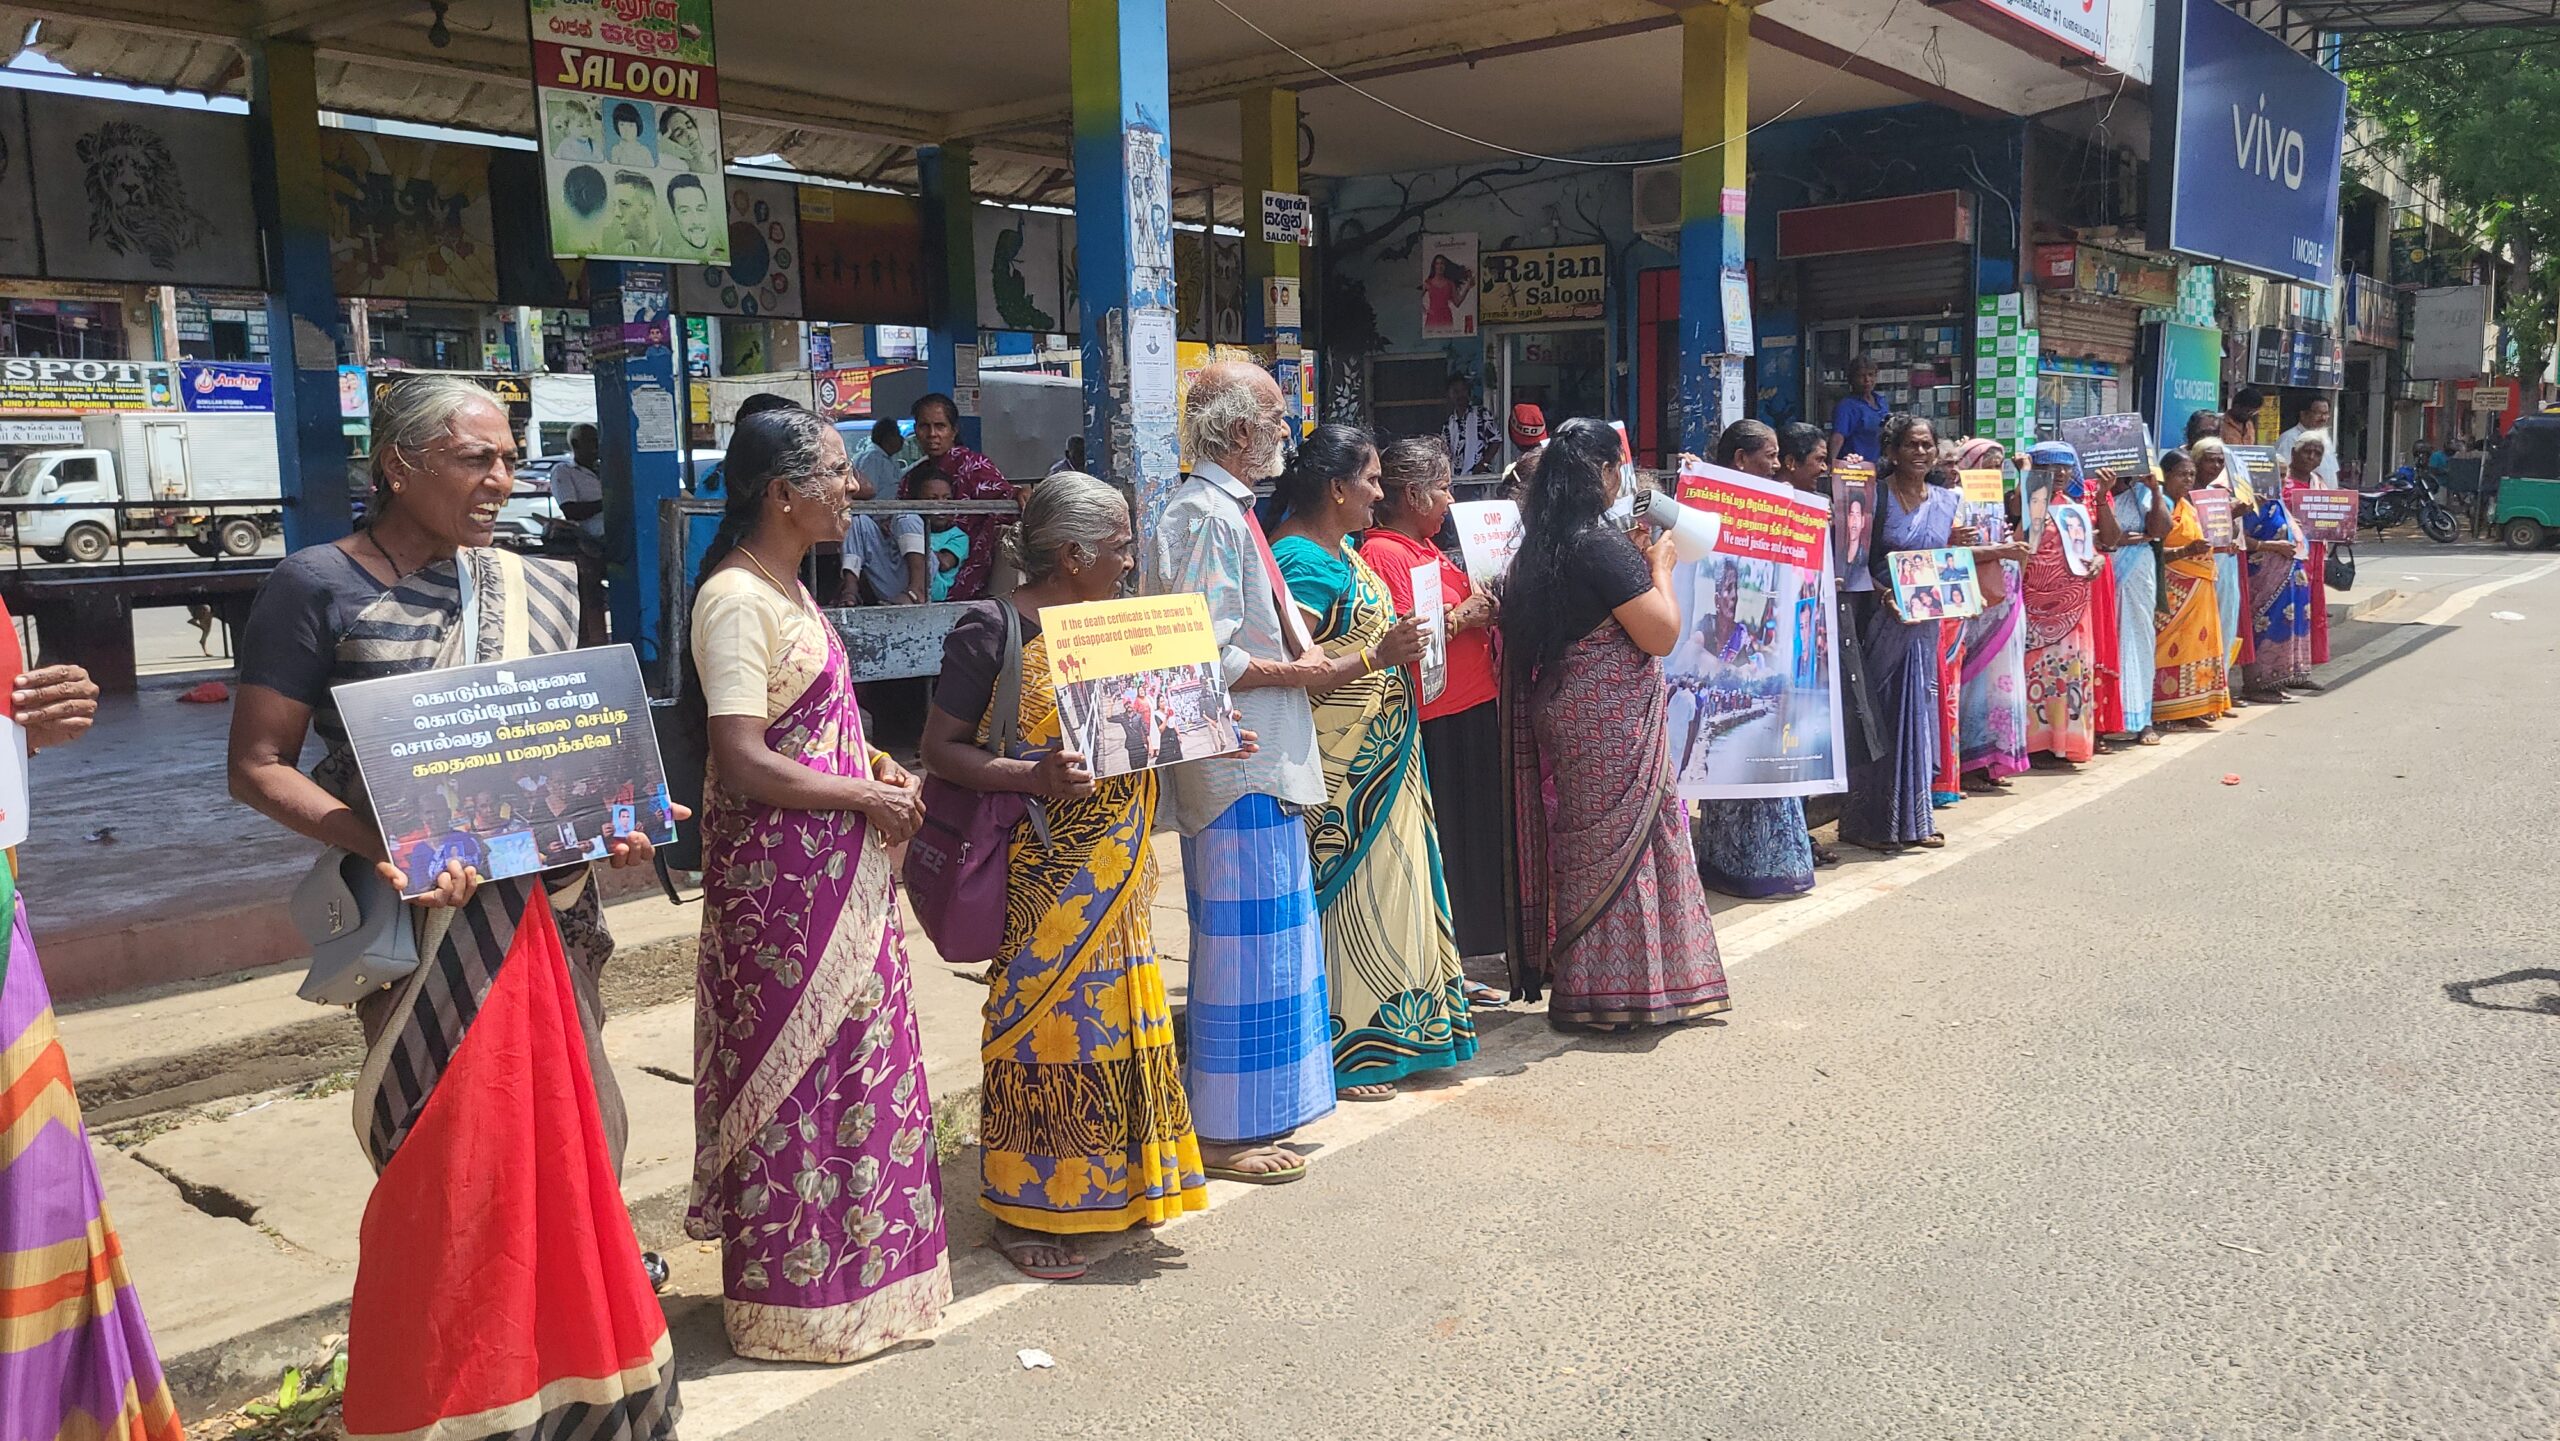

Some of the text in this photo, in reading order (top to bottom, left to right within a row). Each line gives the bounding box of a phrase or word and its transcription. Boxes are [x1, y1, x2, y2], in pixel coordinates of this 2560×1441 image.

[558, 47, 699, 100] SALOON
[2233, 92, 2304, 190] vivo
[1265, 231, 1299, 242] SALOON
[2296, 238, 2323, 267] MOBILE
[1494, 252, 1603, 288] Rajan
[1526, 286, 1601, 305] Saloon
[883, 327, 911, 340] FedEx
[5, 360, 140, 382] SPOT
[215, 373, 261, 387] Anchor
[3, 400, 23, 408] KIND
[25, 400, 36, 408] OF
[37, 400, 67, 408] MOBILE
[69, 401, 111, 409] REPAIRING
[13, 433, 21, 441] &
[26, 432, 65, 442] English
[1484, 513, 1501, 525] OMP
[1723, 531, 1735, 545] We
[1735, 534, 1750, 547] need
[1749, 536, 1770, 551] justice
[1771, 541, 1782, 553] and
[1061, 606, 1192, 632] If the death certificate is the answer to
[1057, 620, 1204, 650] our disappeared children, then who is the
[1130, 642, 1153, 656] killer?
[413, 691, 600, 731] கொடுப்போம் என்று
[390, 707, 628, 758] சொல்வது கொலை செய்த
[412, 752, 502, 778] கதையை
[505, 733, 612, 763] மறைக்கவே
